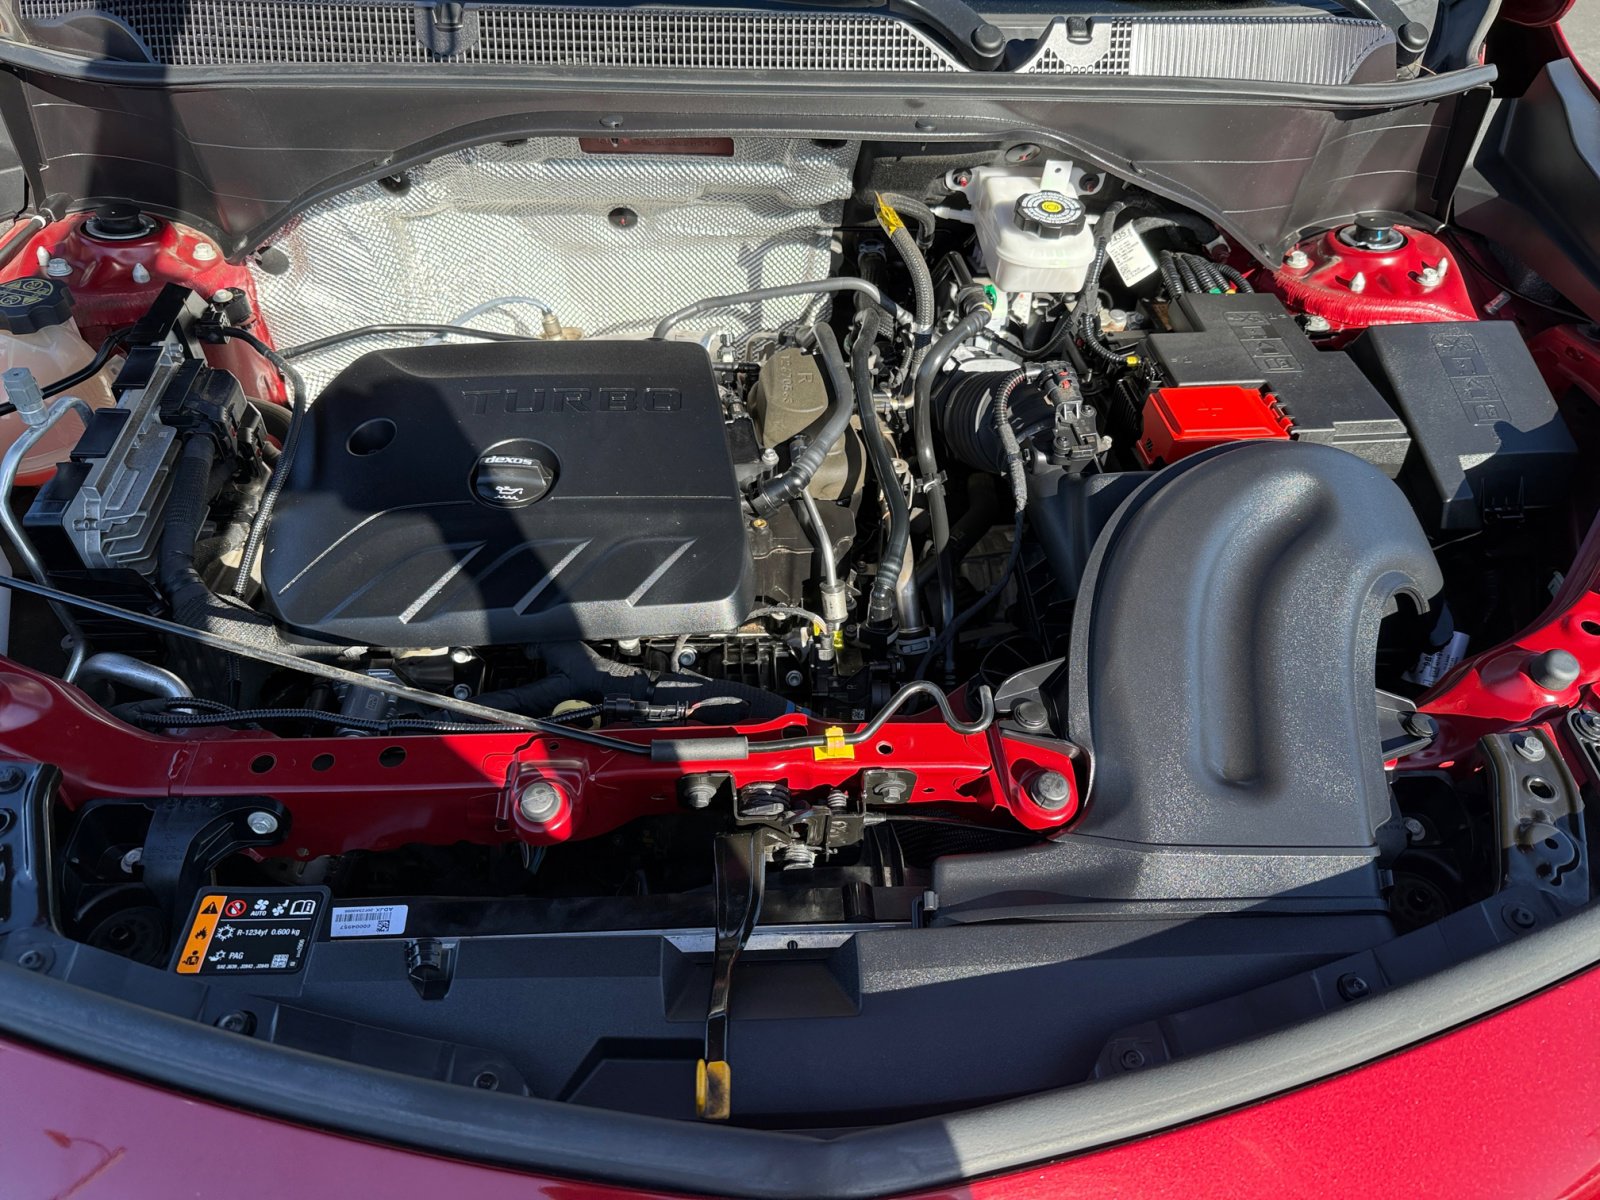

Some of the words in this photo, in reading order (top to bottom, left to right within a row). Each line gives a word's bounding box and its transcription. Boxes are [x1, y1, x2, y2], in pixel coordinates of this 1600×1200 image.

[461, 387, 683, 414] TURBO
[484, 456, 533, 466] dexos
[236, 929, 268, 937] R-1234yf
[291, 928, 301, 936] kg
